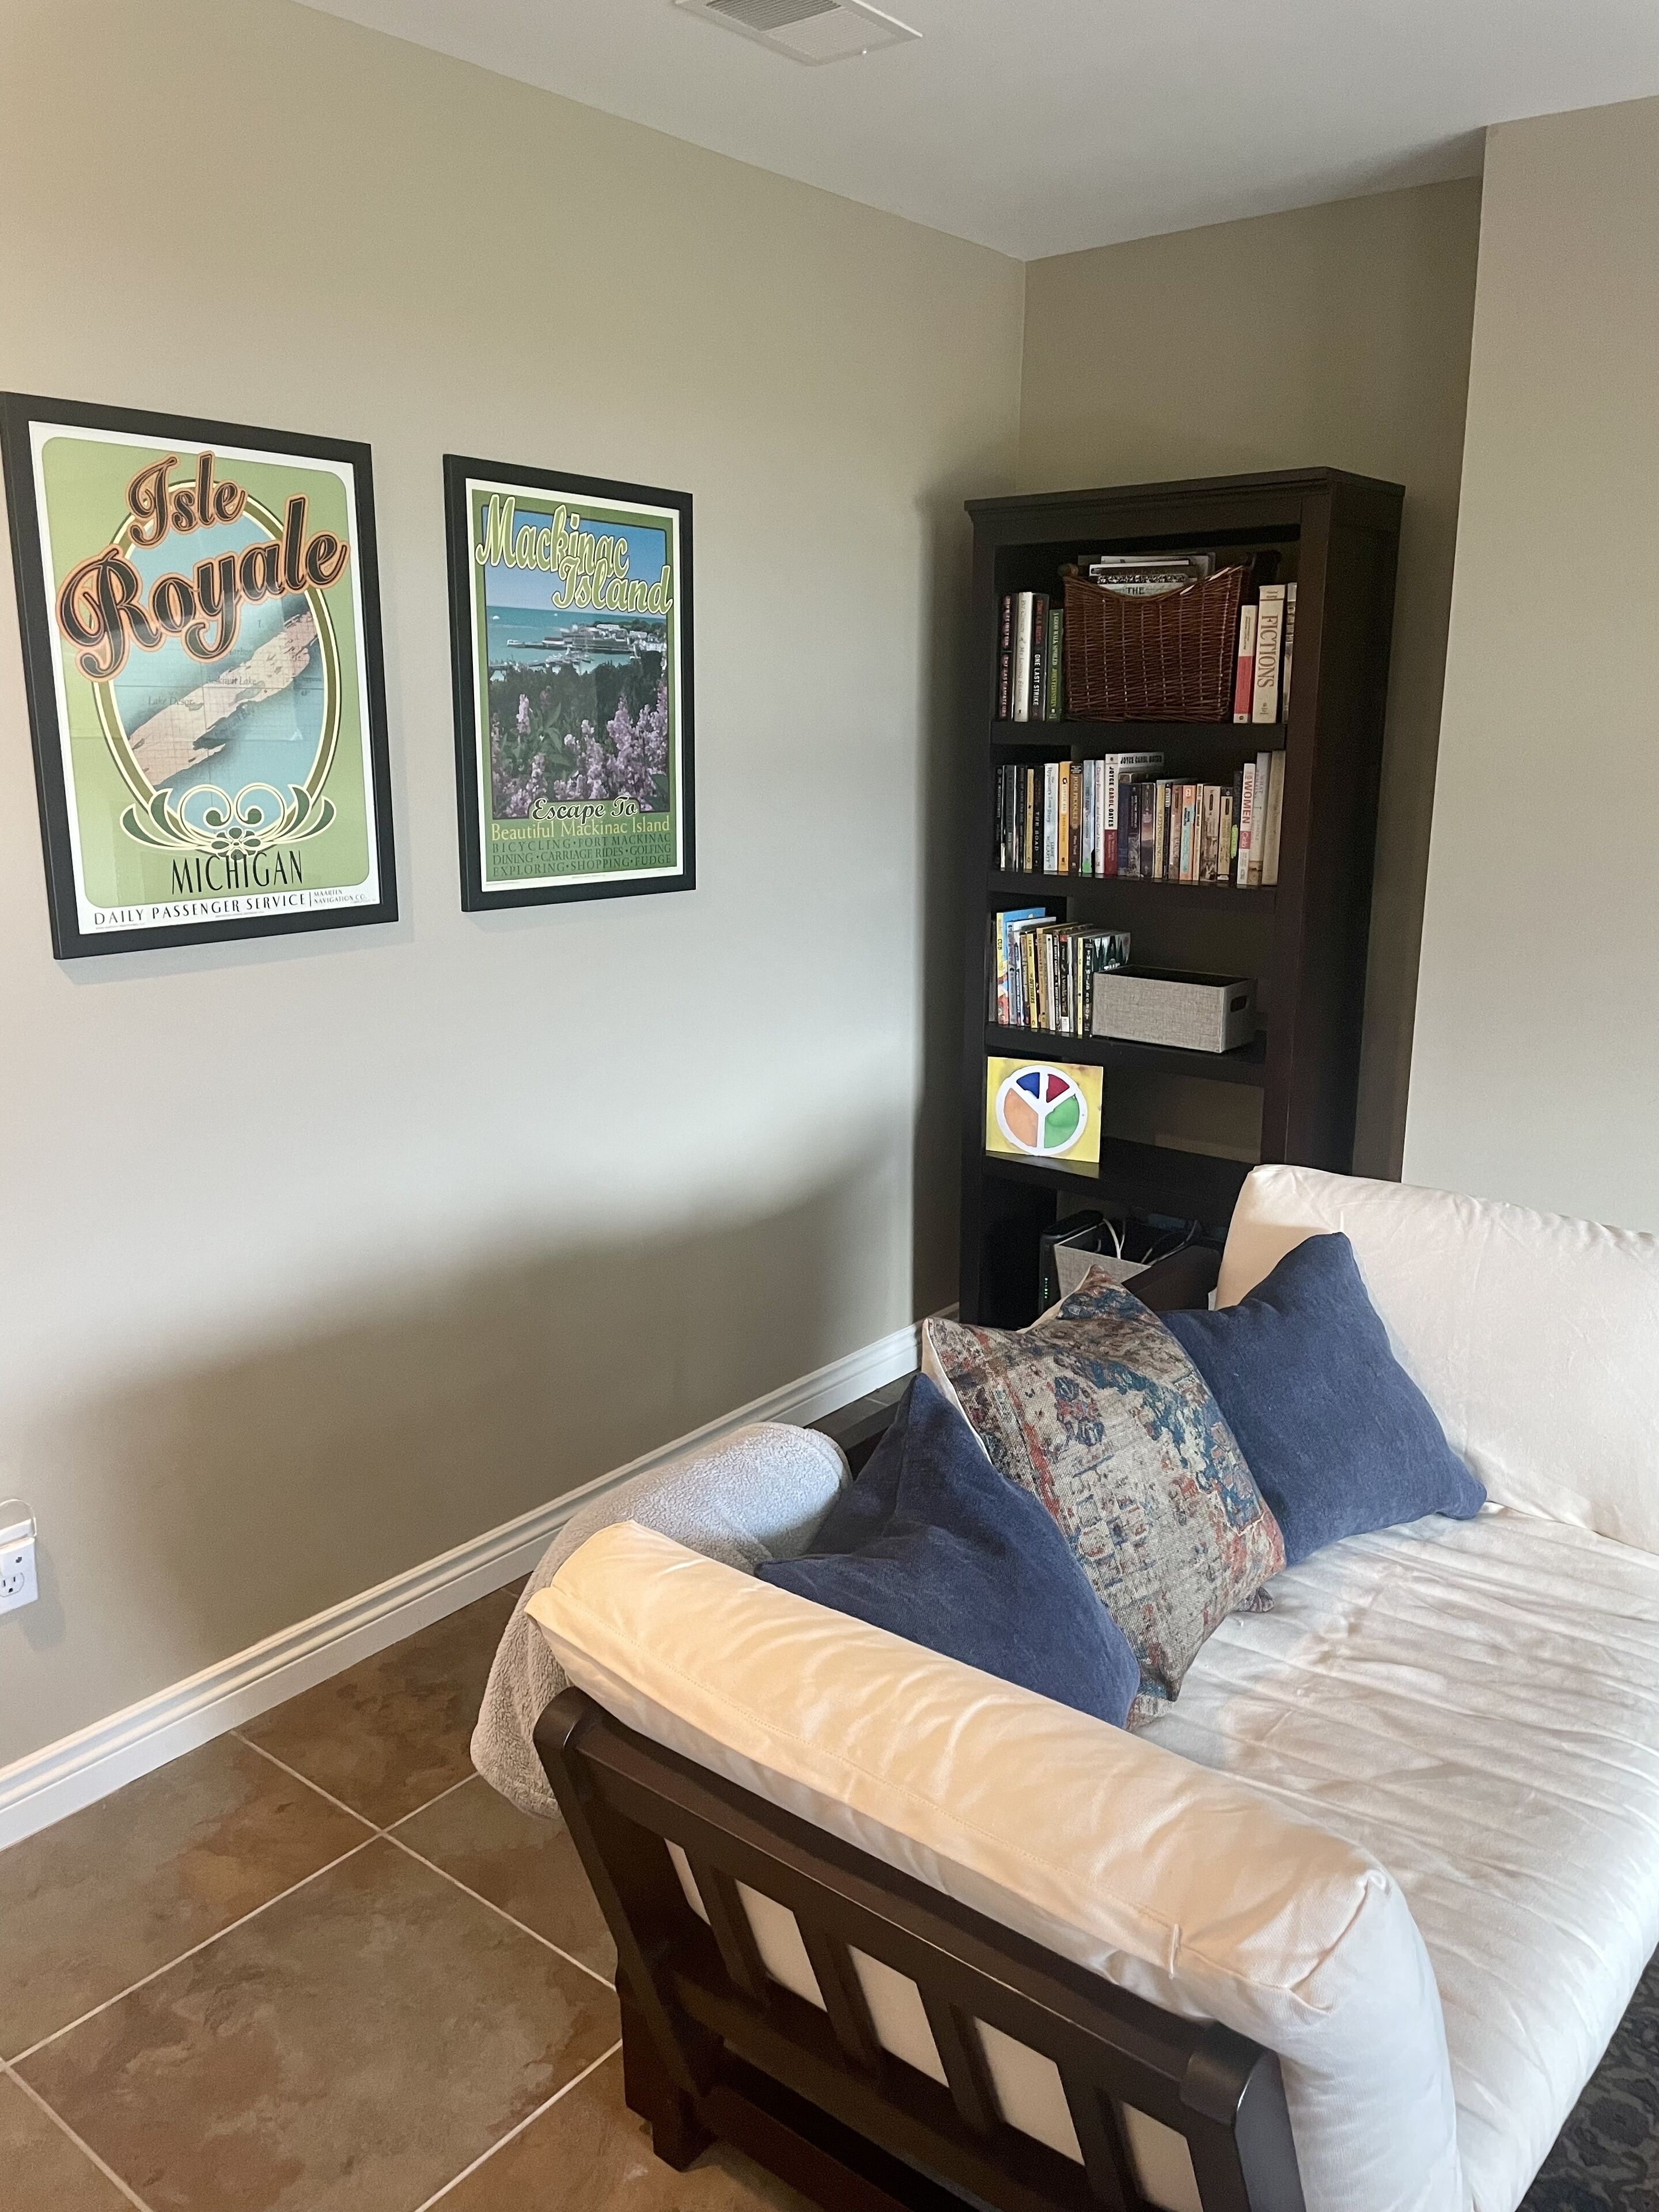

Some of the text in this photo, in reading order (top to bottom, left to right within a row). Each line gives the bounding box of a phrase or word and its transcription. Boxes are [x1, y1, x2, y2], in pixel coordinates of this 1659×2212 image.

[126, 452, 247, 545] Isle
[475, 494, 630, 578] Mackinac
[56, 494, 350, 683] Royale
[552, 556, 673, 615] Island
[1126, 586, 1145, 596] THE
[1257, 614, 1278, 688] FICTIONS
[531, 796, 638, 824] Escape To
[1243, 781, 1252, 824] WOMEN
[491, 815, 670, 841] Beautiful Mackinac Island
[493, 839, 570, 853] BICYCLING
[612, 833, 671, 846] MACKINAC
[493, 843, 671, 865] DINING CARRIAGE RIDES GOLFING
[493, 862, 565, 876] EXPLORING
[571, 857, 630, 871] SHOPPING
[635, 854, 671, 866] FUDGE
[171, 850, 304, 896] MICHIGAN
[94, 909, 144, 926] DAILY
[152, 899, 241, 920] PASSENGER
[246, 893, 306, 910] SERVICE
[314, 895, 353, 904] NAVIGATION
